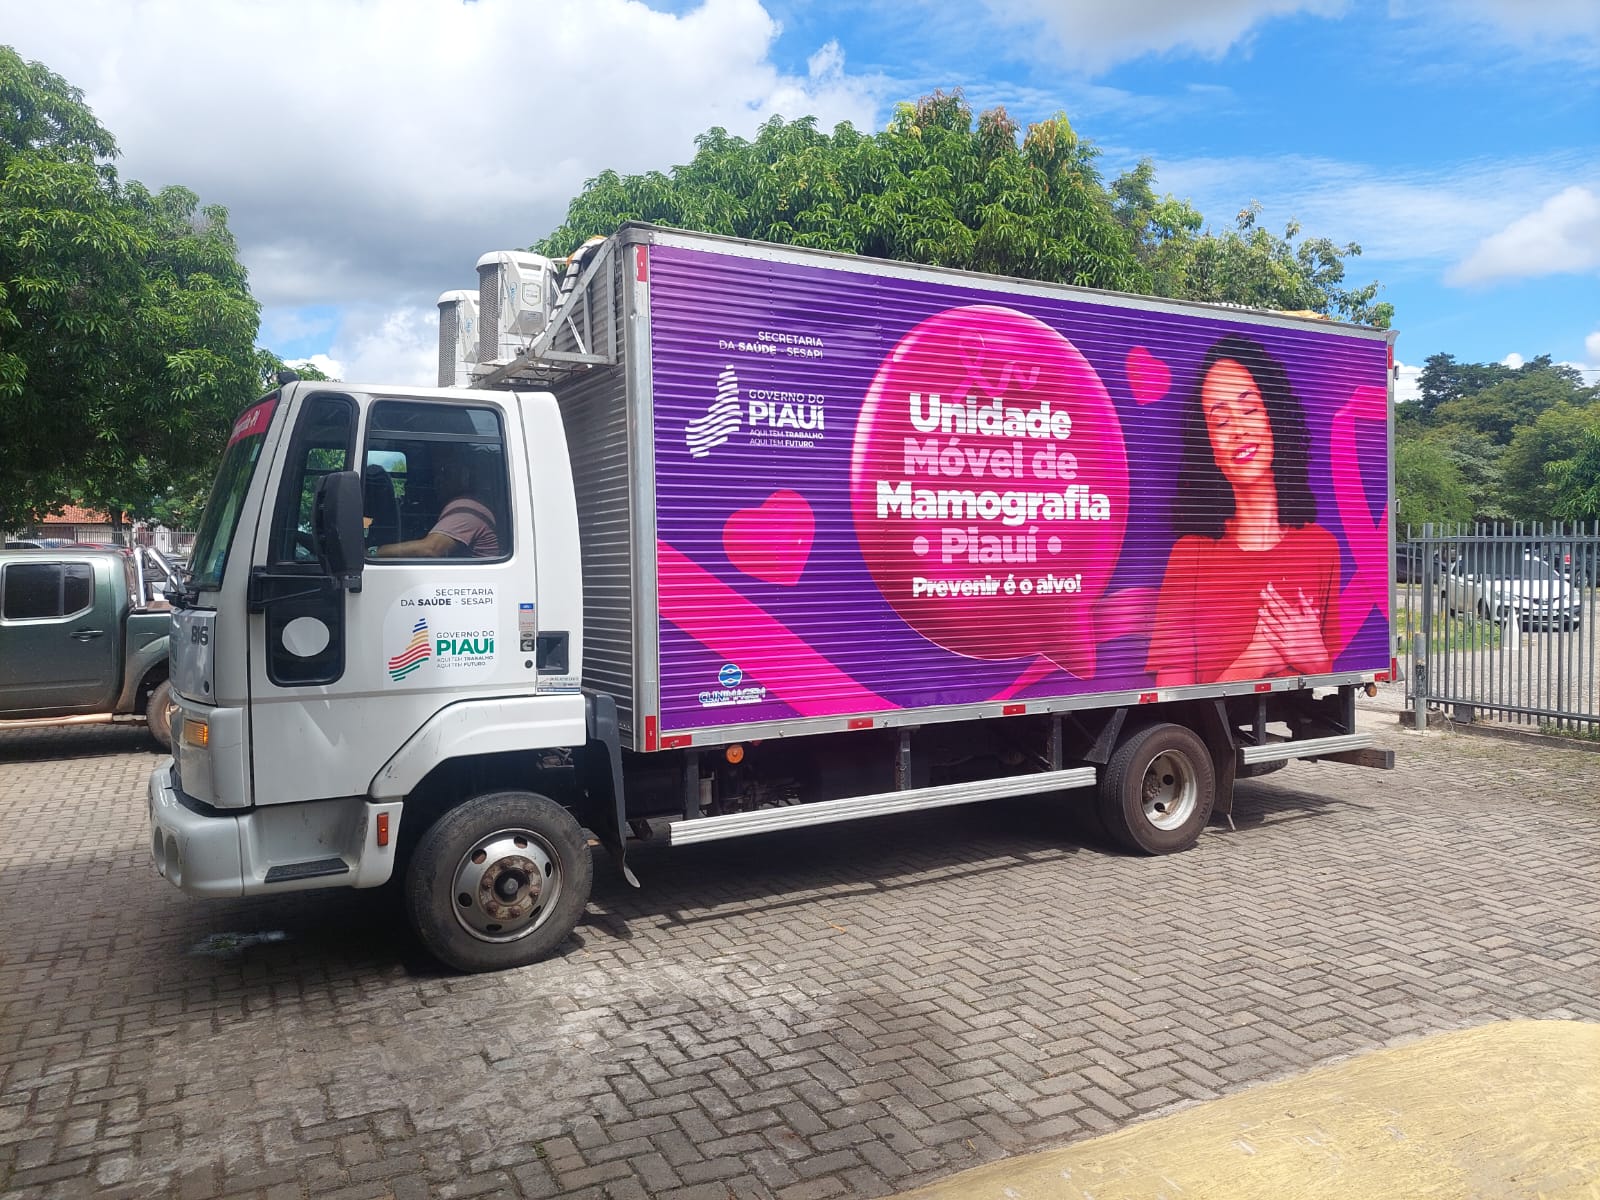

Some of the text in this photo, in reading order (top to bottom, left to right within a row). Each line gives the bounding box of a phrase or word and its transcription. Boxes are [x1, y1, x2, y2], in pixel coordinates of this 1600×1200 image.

[758, 331, 824, 347] SECRETARIA
[719, 340, 735, 350] DA
[738, 341, 777, 355] SAÚDE
[787, 347, 824, 359] SESAPI
[749, 389, 825, 404] GOVERNO DO
[749, 400, 825, 430] PIAUÍ
[909, 392, 1073, 440] Unidade
[903, 437, 1079, 480] Móvel de
[876, 480, 1111, 526] Mamografia
[941, 525, 1040, 564] Piauí
[435, 588, 494, 597] SECRETARIA
[912, 573, 1082, 598] Prevenir é o alvo!
[400, 599, 415, 607] DA
[417, 596, 452, 606] SAÚDE
[460, 597, 493, 605] SESAPI
[436, 630, 480, 639] GOVERNO
[436, 638, 495, 656] PIAUÍ
